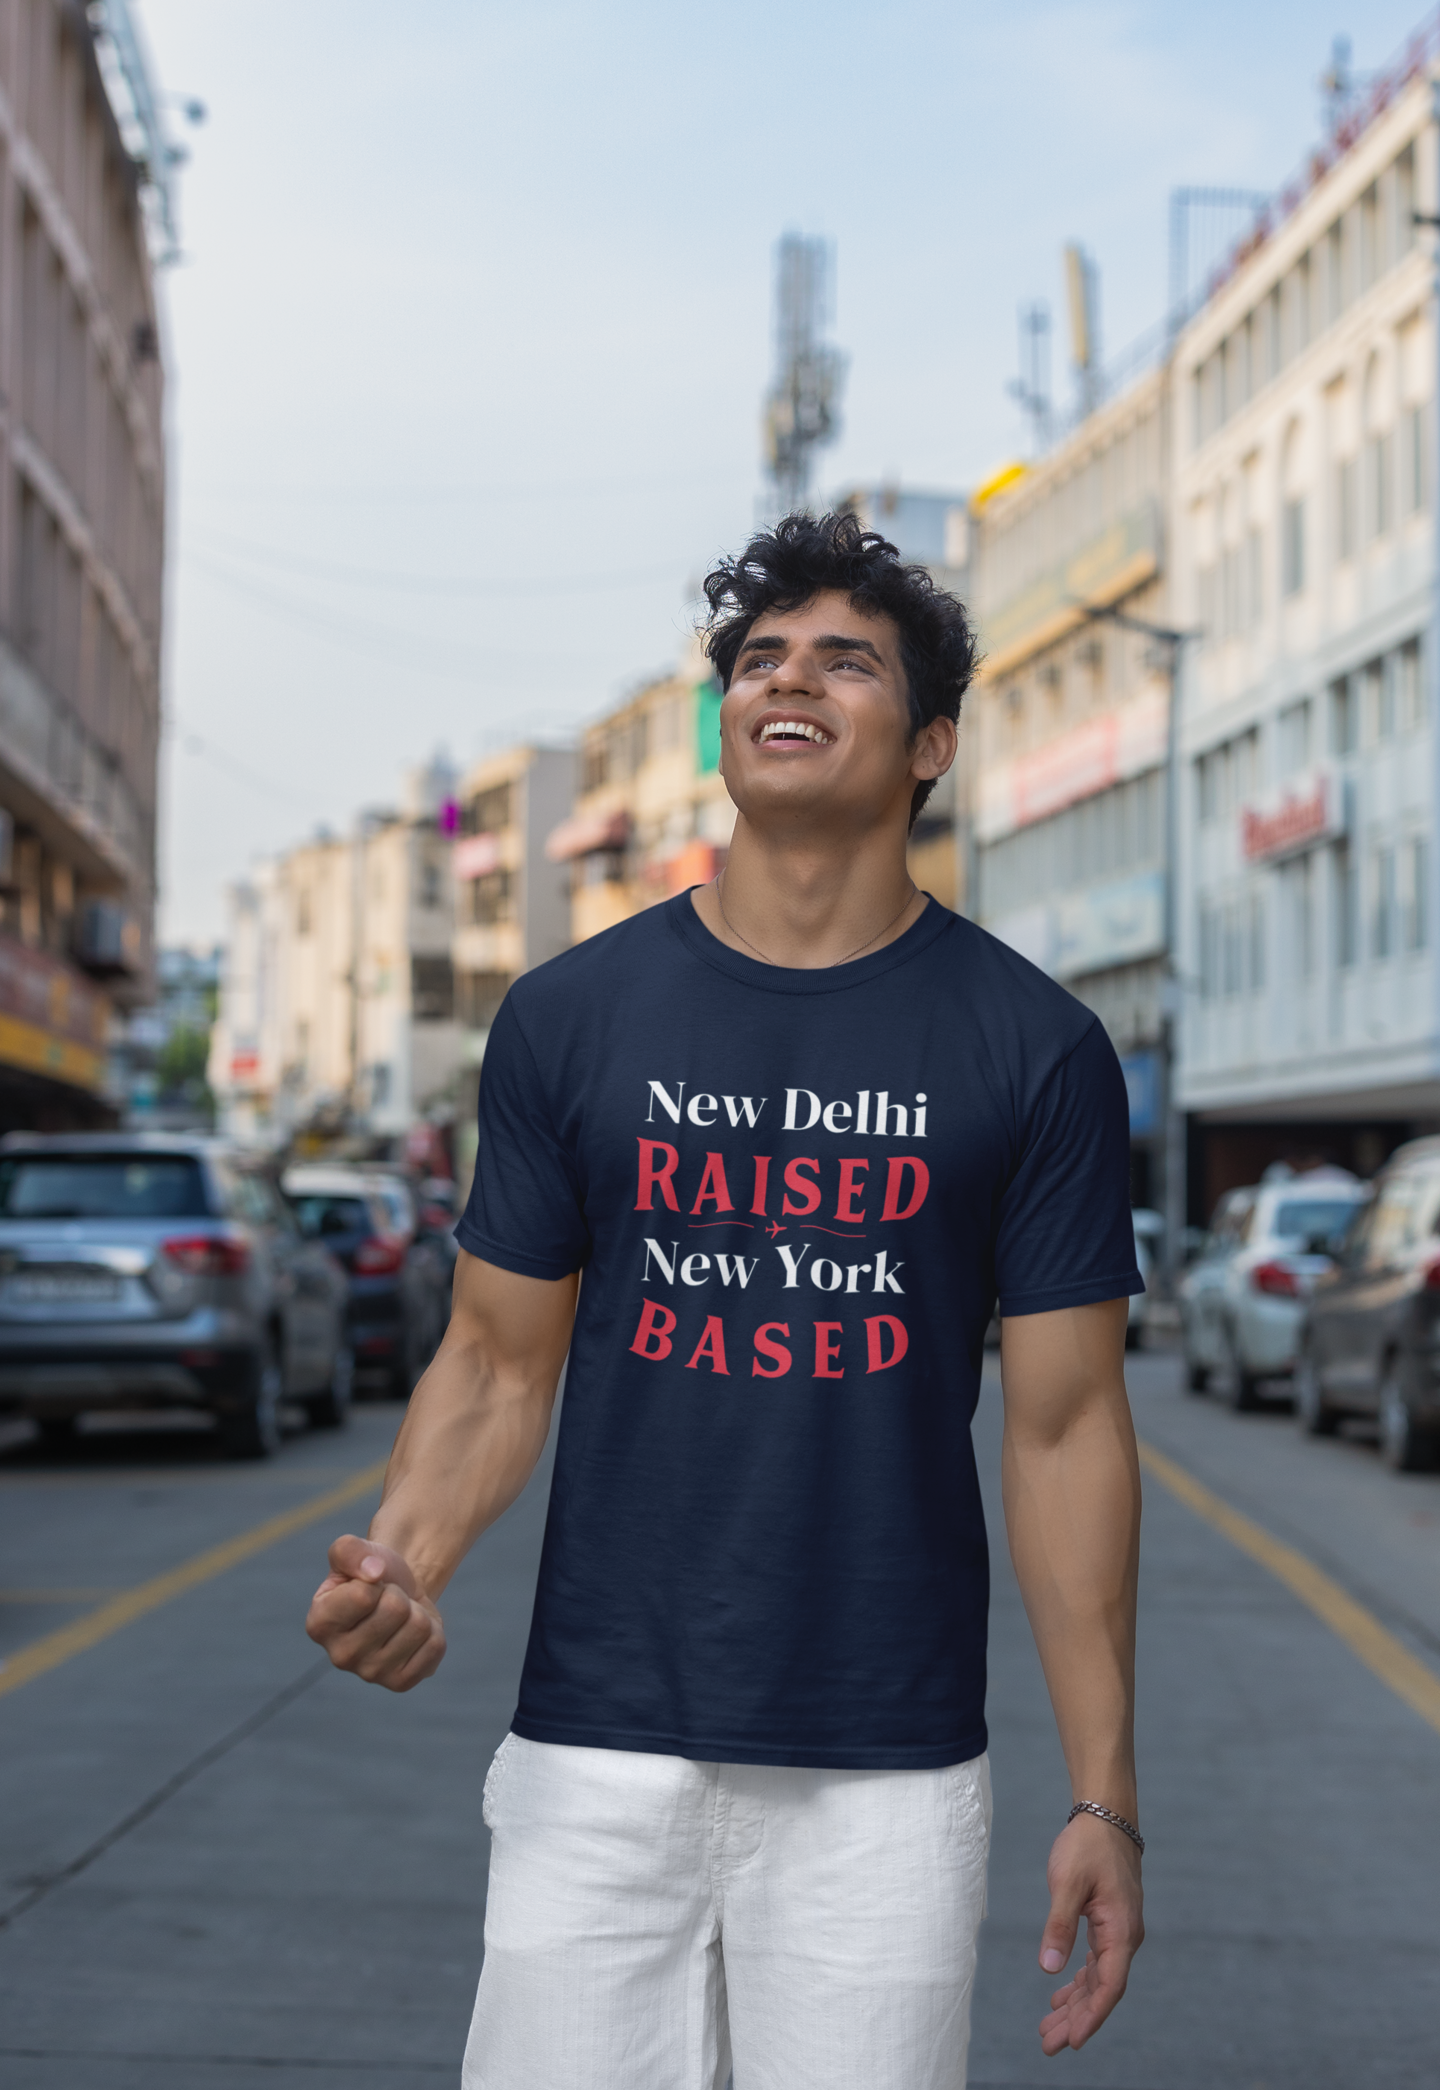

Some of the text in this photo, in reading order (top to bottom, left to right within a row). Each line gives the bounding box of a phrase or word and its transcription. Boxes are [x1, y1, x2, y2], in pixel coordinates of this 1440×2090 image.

[645, 1080, 928, 1137] New Delhi
[633, 1136, 930, 1223] RAISED
[641, 1237, 906, 1294] New York
[628, 1297, 910, 1379] BASED
